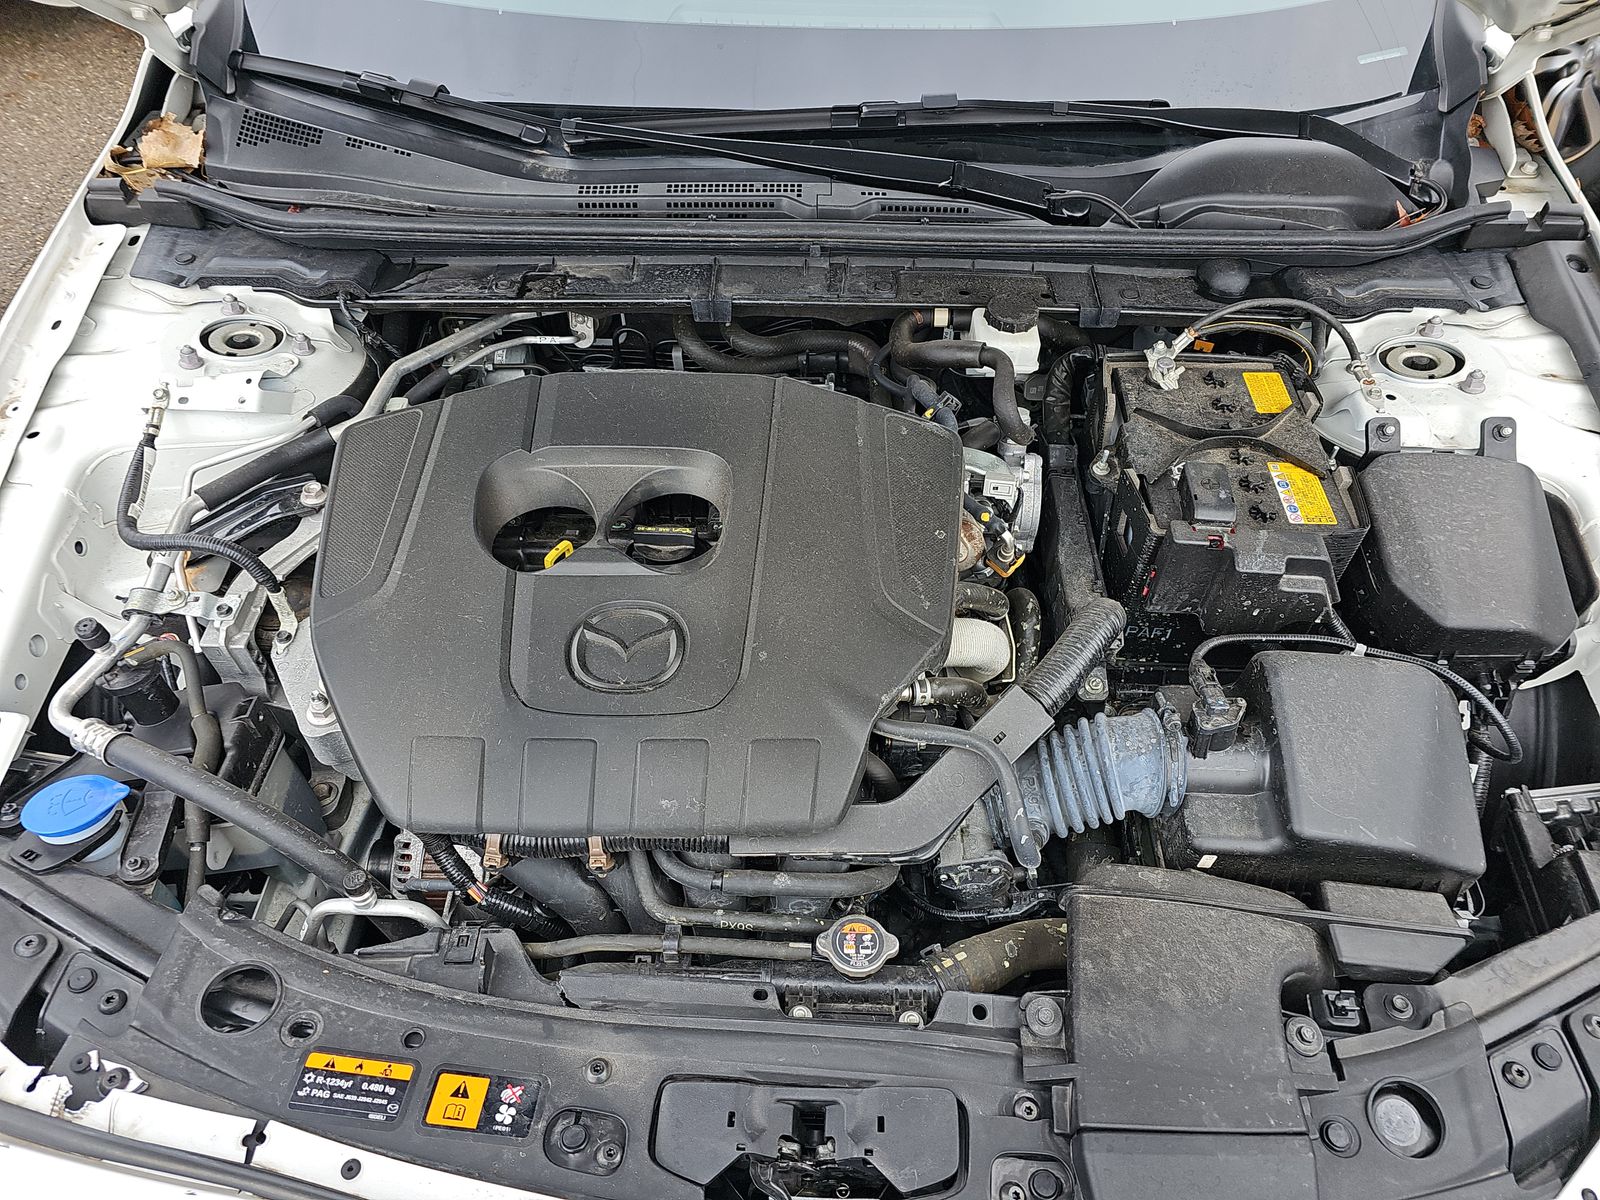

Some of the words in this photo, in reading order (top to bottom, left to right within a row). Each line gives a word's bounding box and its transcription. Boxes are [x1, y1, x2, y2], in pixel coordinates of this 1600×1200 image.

[1125, 625, 1172, 639] PAF1
[315, 1076, 354, 1089] R-1234yf
[361, 1082, 384, 1093] 0.480
[384, 1084, 396, 1095] kg
[310, 1088, 331, 1098] PAG
